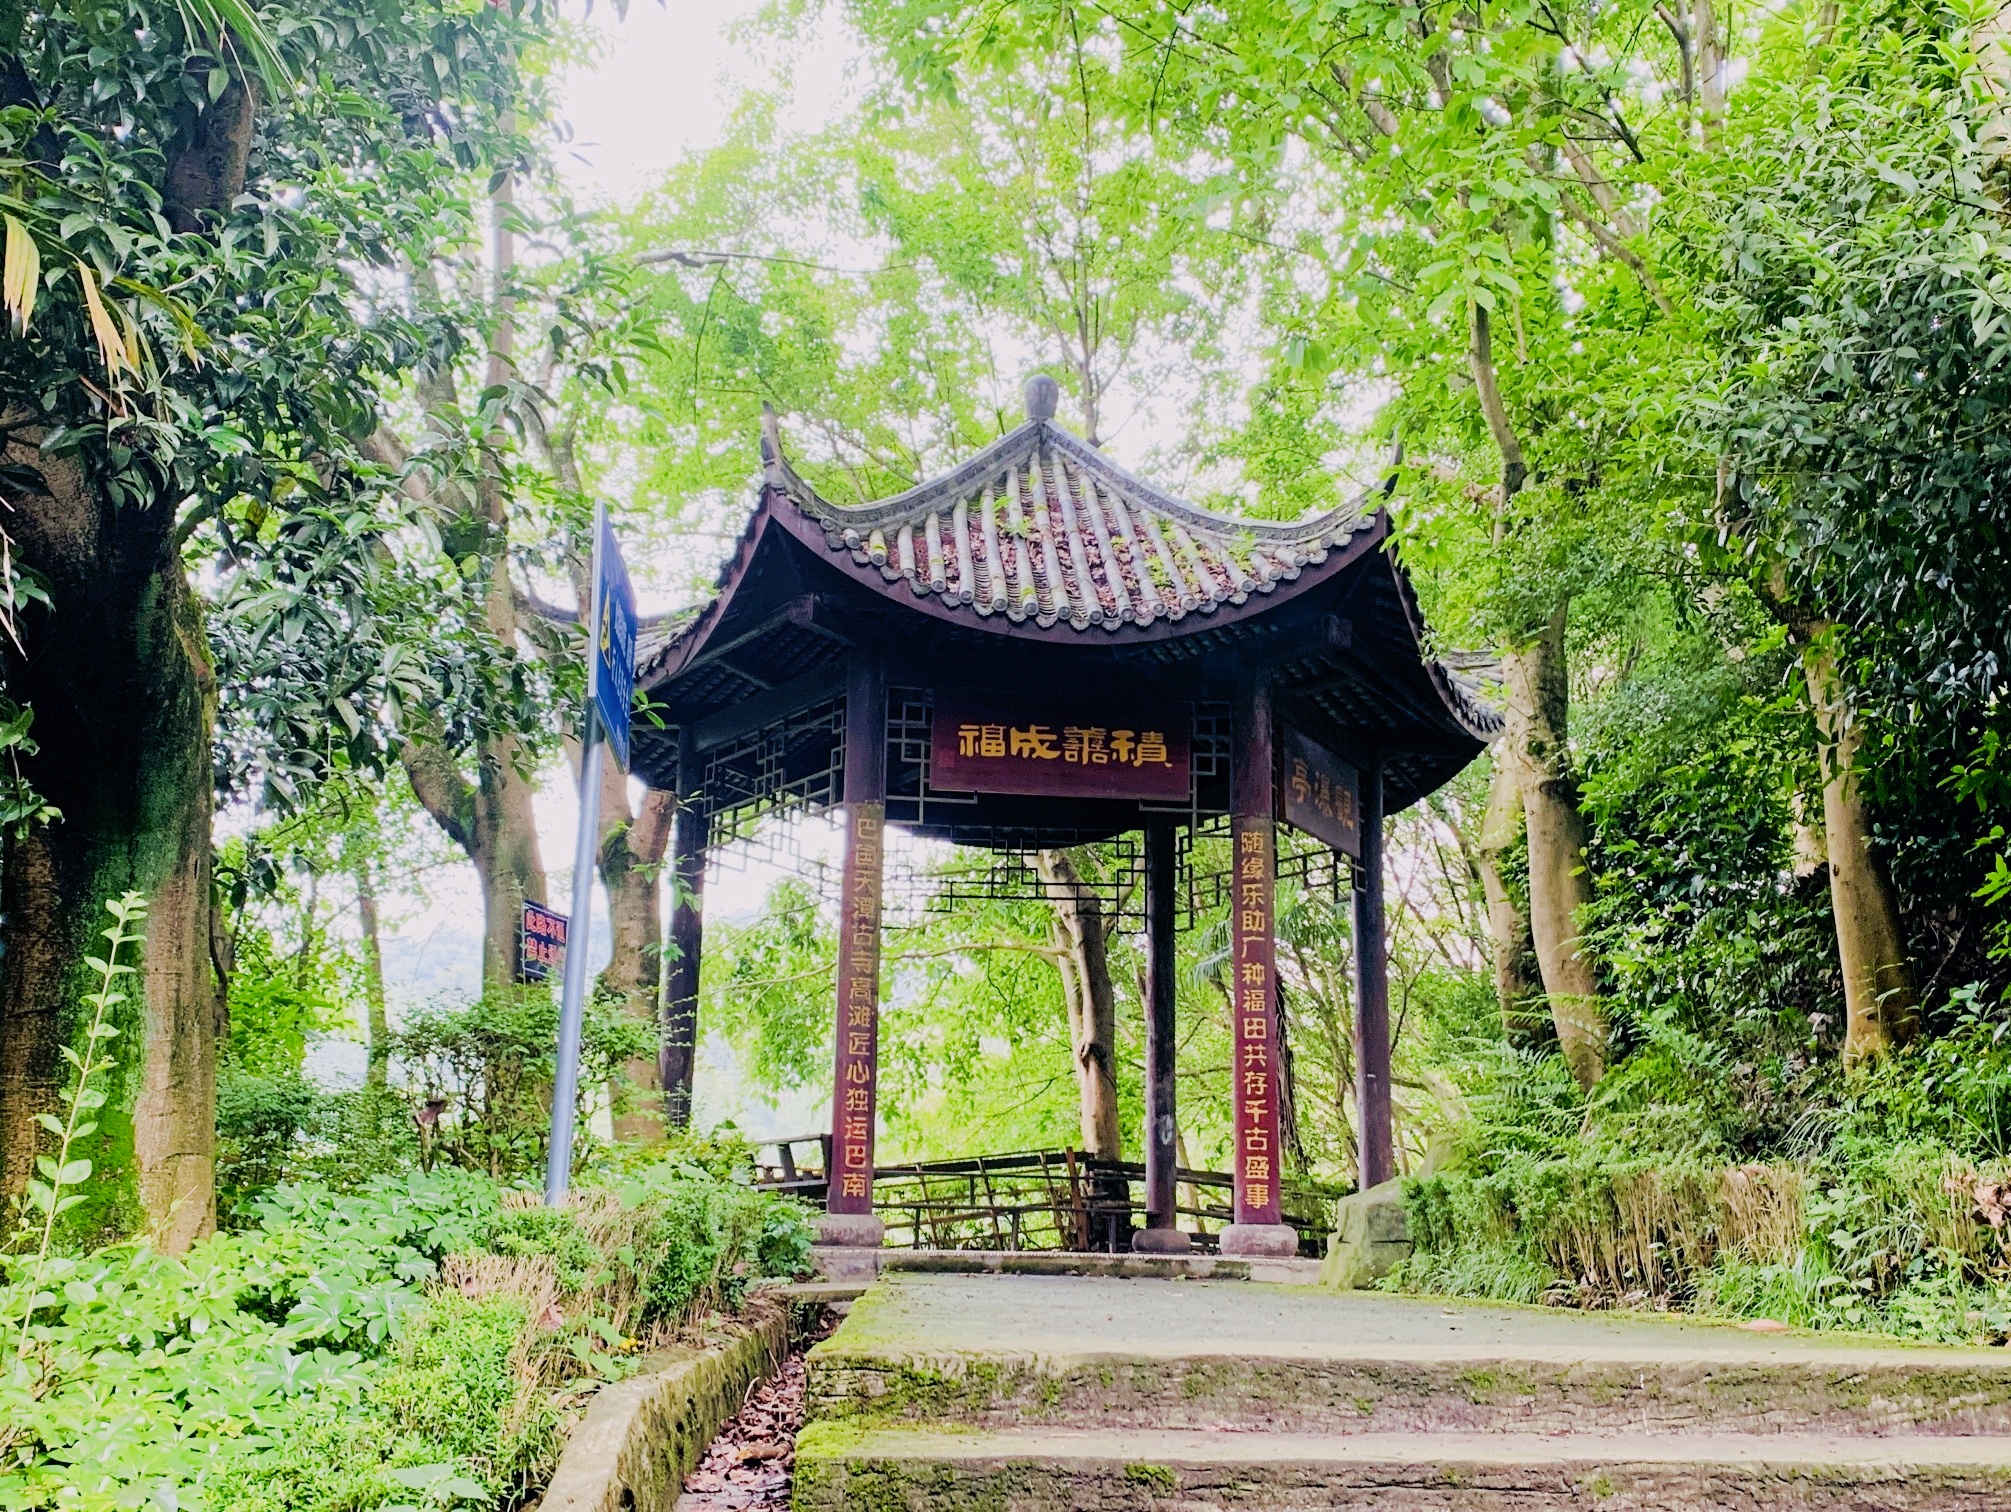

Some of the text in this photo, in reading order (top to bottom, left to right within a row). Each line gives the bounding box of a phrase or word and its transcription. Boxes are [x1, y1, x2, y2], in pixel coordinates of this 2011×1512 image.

[1241, 831, 1270, 1210] 随缘乐助广种福田共存千古盛事
